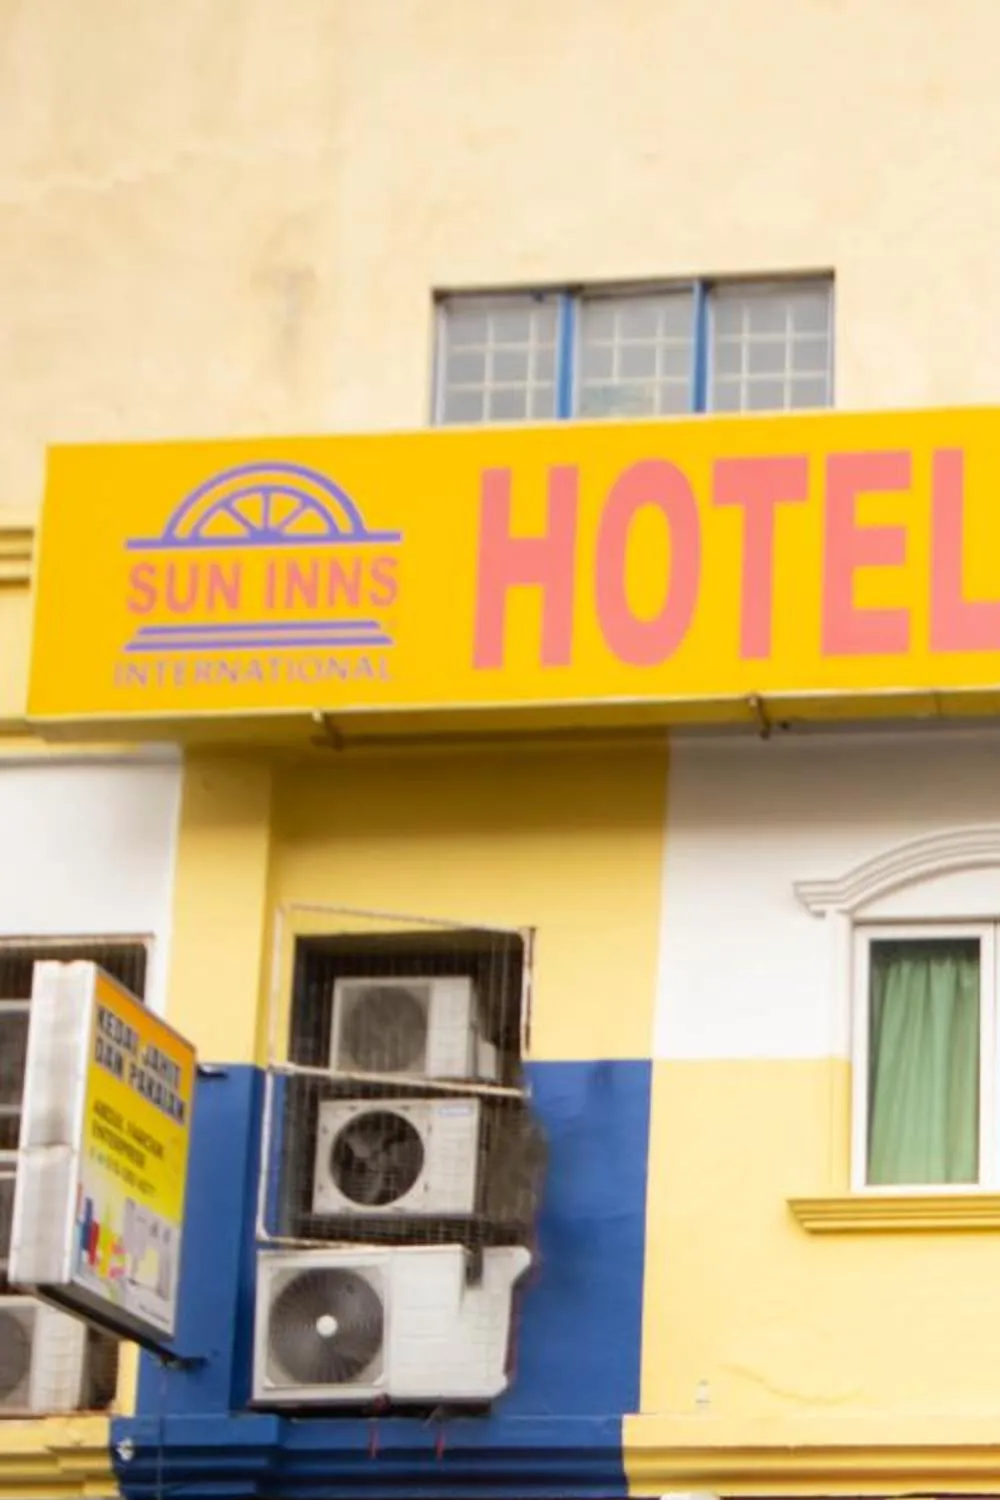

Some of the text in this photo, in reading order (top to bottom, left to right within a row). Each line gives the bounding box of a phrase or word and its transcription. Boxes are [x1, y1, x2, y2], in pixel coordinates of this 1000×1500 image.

[127, 555, 399, 615] SUN INNS
[113, 655, 393, 689] INTERNATIONAL
